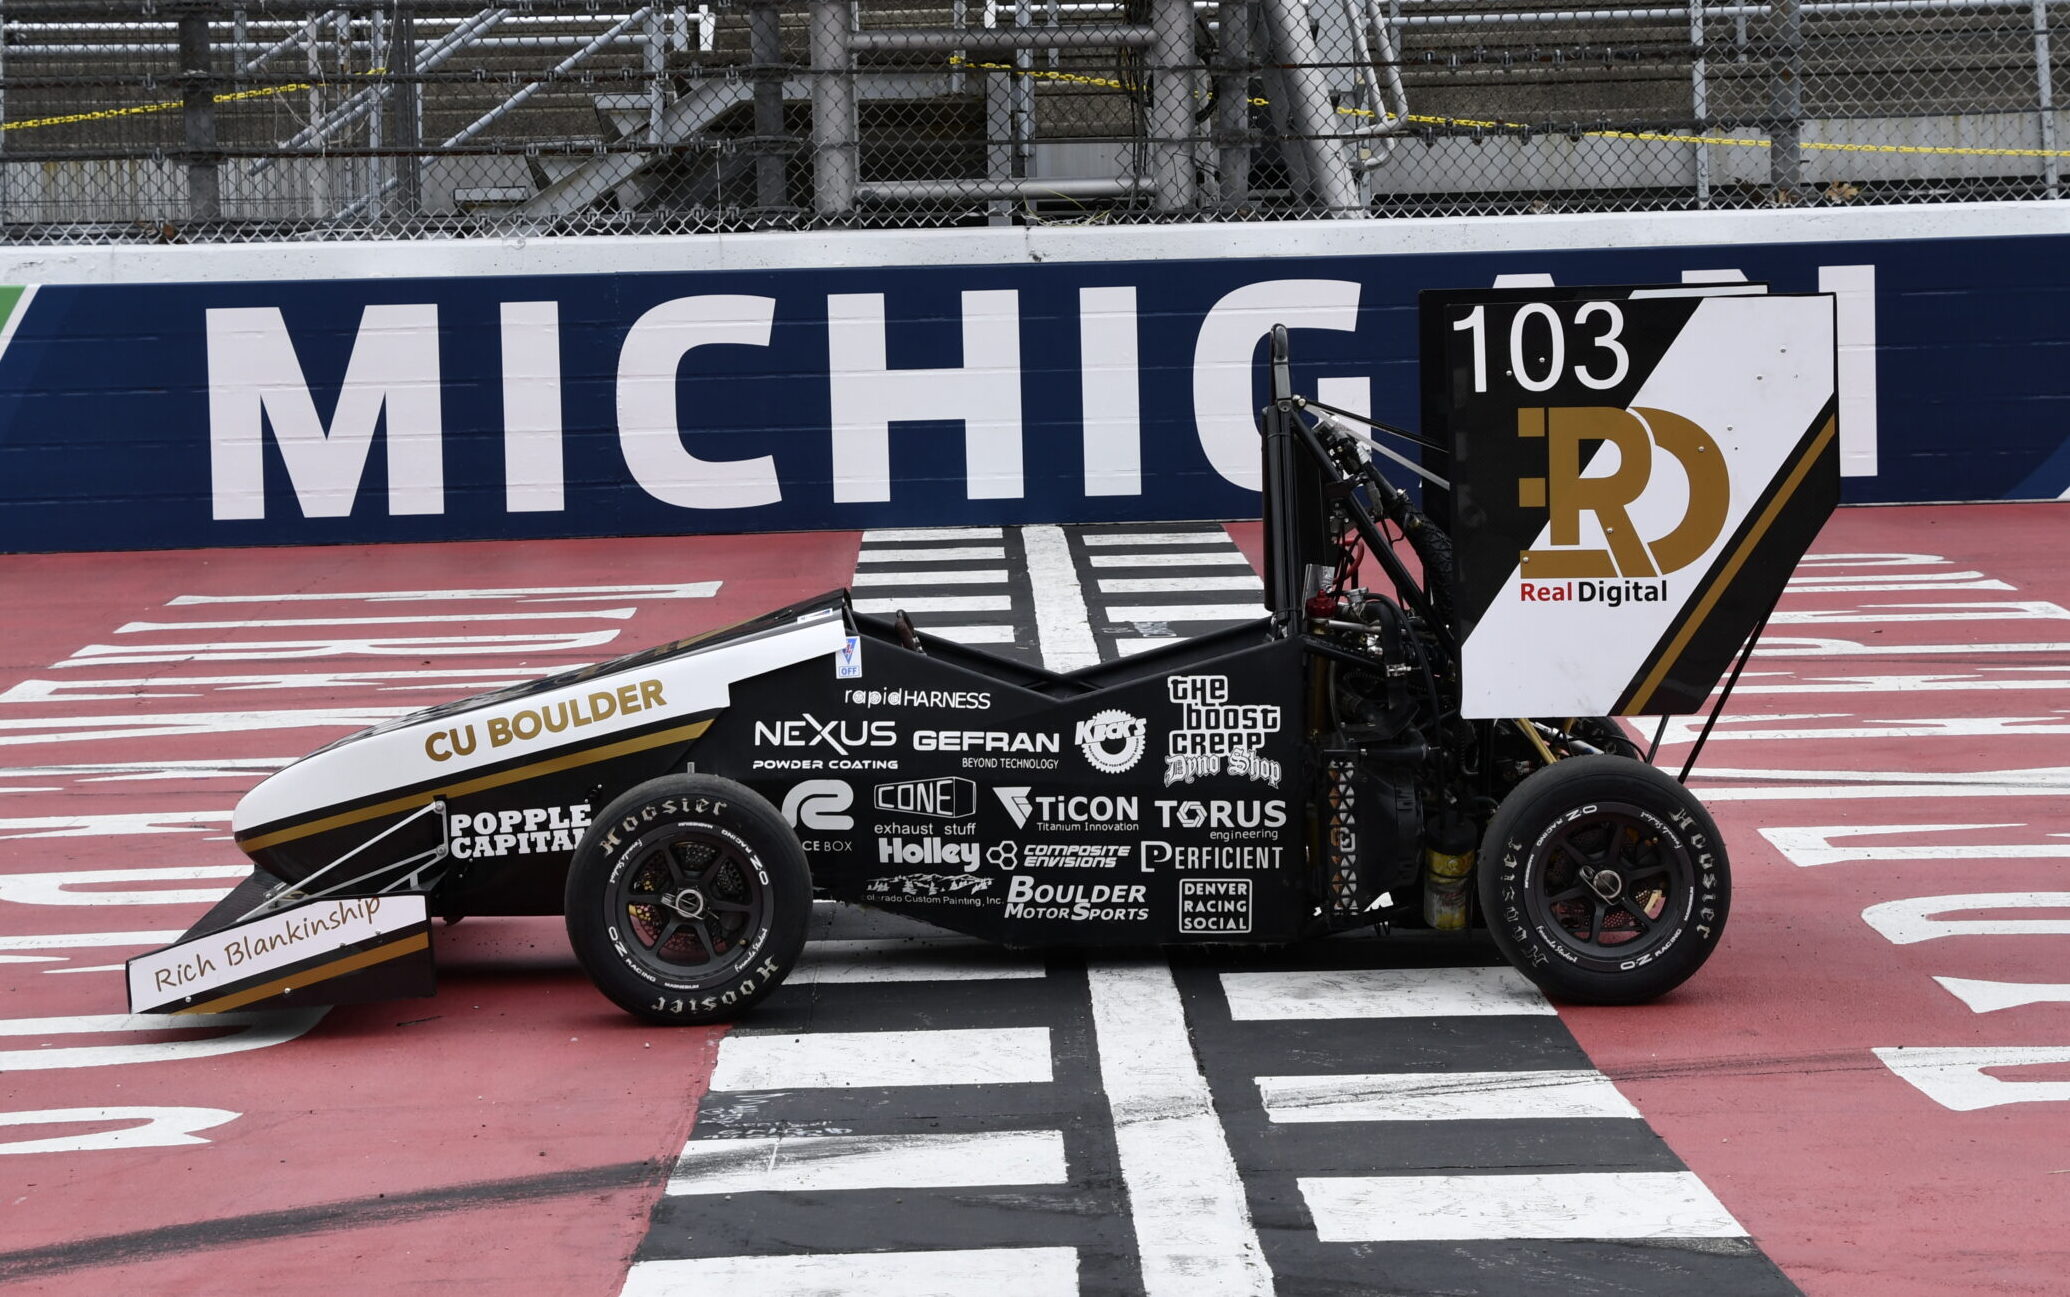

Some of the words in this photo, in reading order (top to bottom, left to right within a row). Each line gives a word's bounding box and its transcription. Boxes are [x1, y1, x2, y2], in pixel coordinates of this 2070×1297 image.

[1452, 300, 1630, 393] 103
[205, 264, 1878, 520] MICHIG
[1520, 581, 1573, 602] Real
[1578, 579, 1668, 608] Digital
[841, 667, 858, 676] OFF
[425, 723, 478, 762] CU
[487, 679, 668, 748] BOULDER
[1183, 705, 1281, 732] boost
[754, 713, 898, 756] NEXUS
[912, 731, 1060, 753] GEFRAN
[752, 759, 824, 770] POWDER
[828, 760, 899, 770] COATING
[962, 757, 998, 768] BEYOND
[1000, 757, 1059, 770] TECHNOLOGY
[1164, 753, 1221, 788] Dyno
[1228, 748, 1283, 790] Shop
[878, 778, 954, 816] CONE
[1036, 796, 1139, 822] TiCON
[450, 803, 593, 838] POPPLE
[600, 798, 728, 858] Hoosier
[874, 822, 934, 835] exhaust
[944, 822, 977, 835] stuff
[1037, 822, 1081, 831] Titanium
[1084, 822, 1139, 832] Innovation
[1155, 800, 1287, 829] TORUS
[824, 841, 853, 852] BOX
[1209, 829, 1279, 842] engineering
[1536, 818, 1563, 847] RACING
[879, 837, 981, 873] Holley
[1022, 856, 1117, 868] ENVISIONS
[1023, 845, 1131, 857] COMPOSITE
[1141, 840, 1284, 873] PERFICIENT
[1669, 807, 1718, 940] Hoosier
[904, 894, 941, 904] Custom
[943, 896, 985, 907] Painting,
[986, 896, 1005, 905] Inc.
[1007, 875, 1147, 903] BOULDER
[1184, 882, 1248, 896] DENVER
[1184, 900, 1247, 913] RACING
[1184, 917, 1247, 930] SOCIAL
[155, 947, 215, 992] Rich
[223, 897, 382, 967] Blankinship
[1655, 928, 1682, 957] RACING
[627, 959, 656, 983] RACING
[652, 955, 780, 1014] Hoosier
